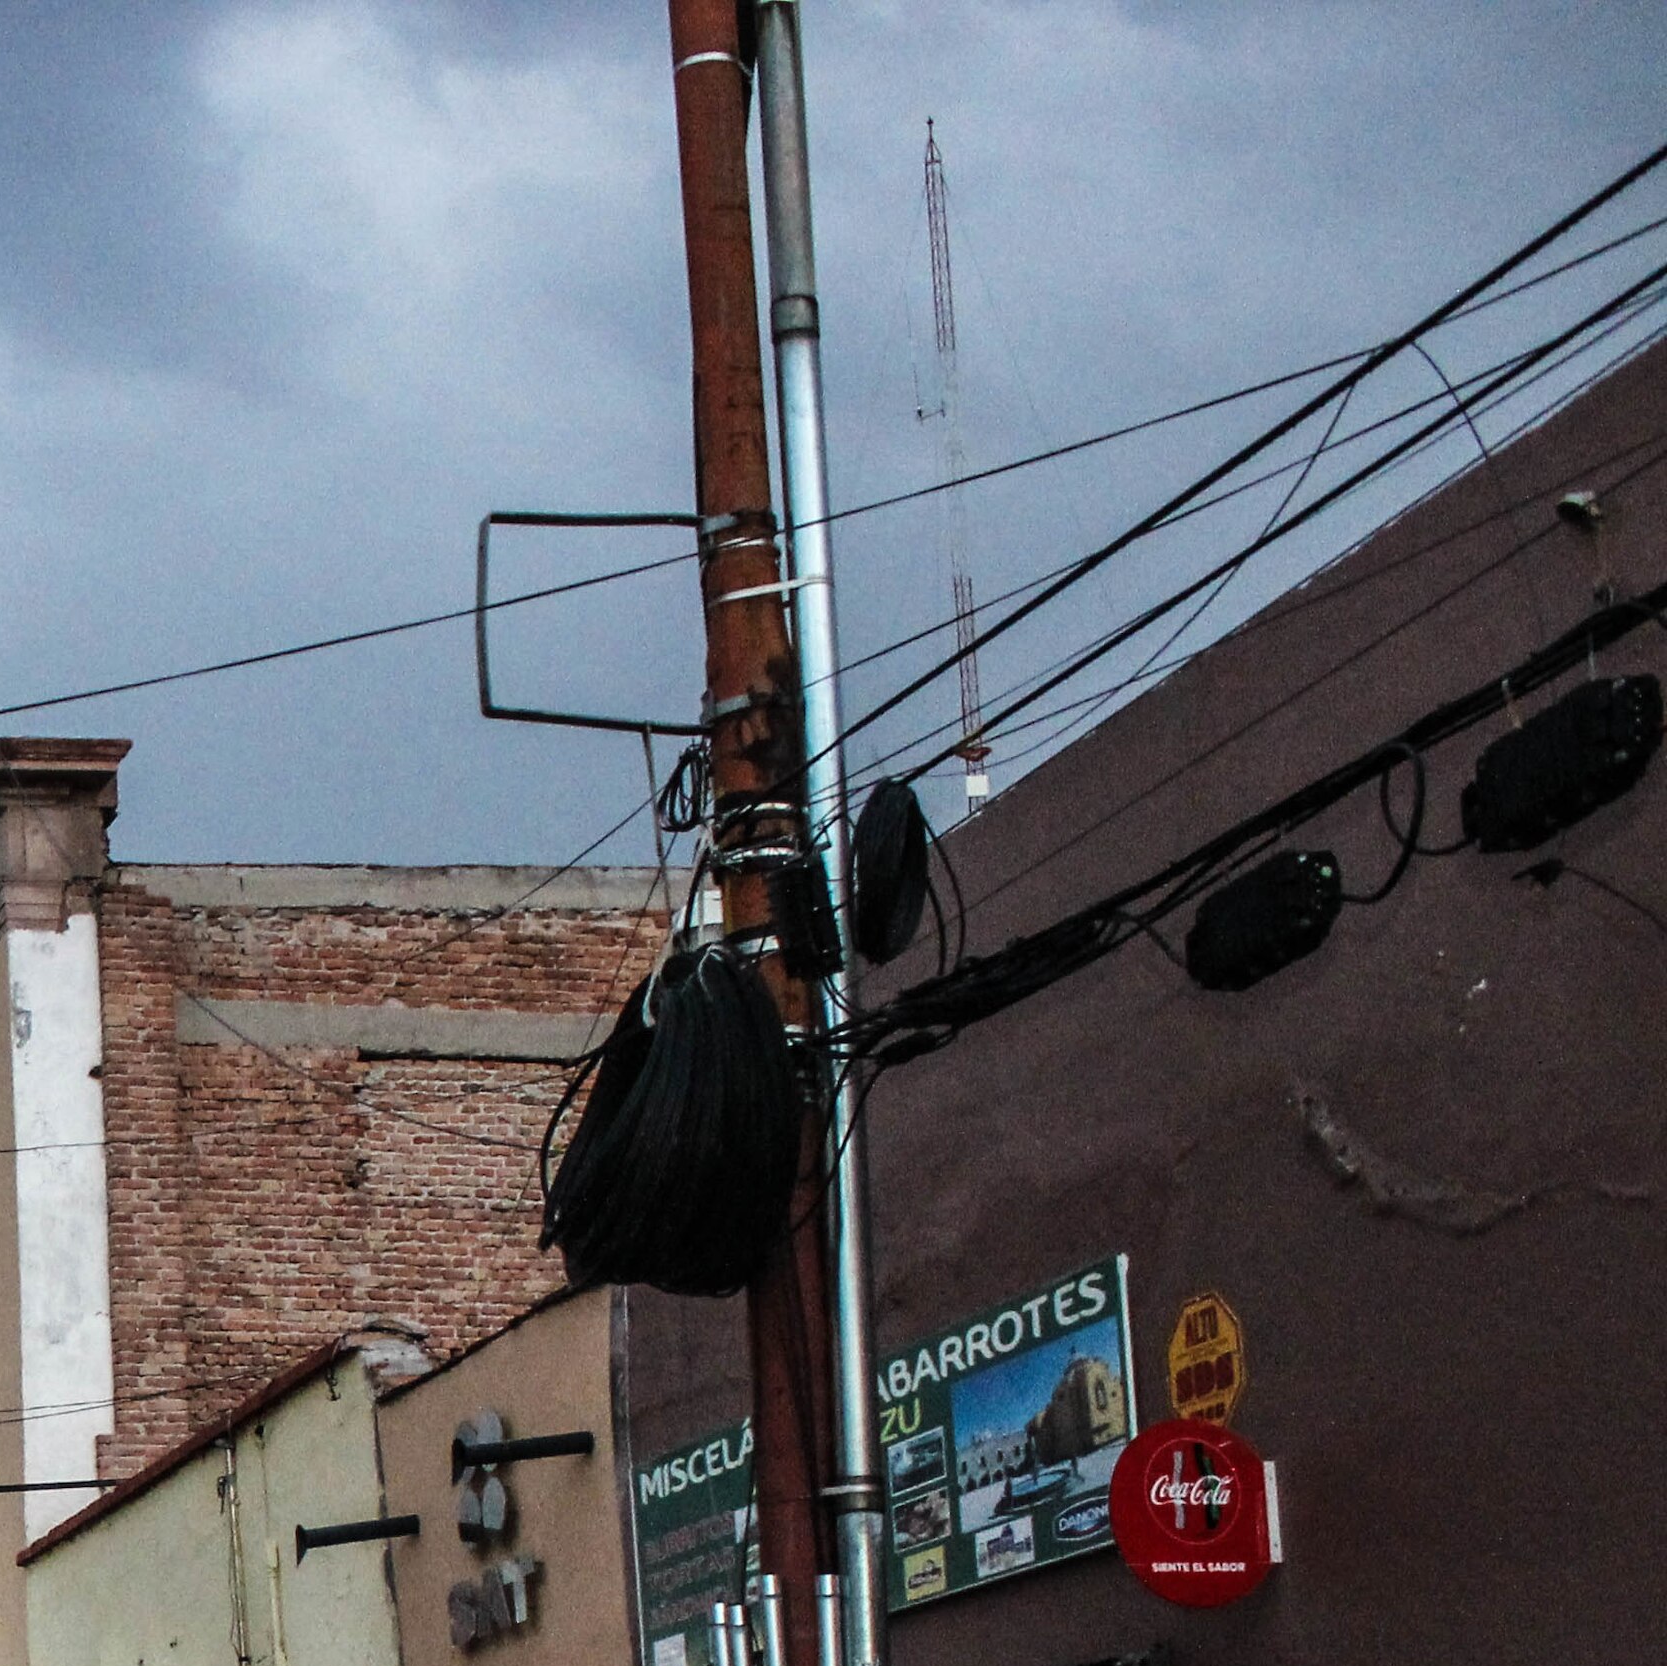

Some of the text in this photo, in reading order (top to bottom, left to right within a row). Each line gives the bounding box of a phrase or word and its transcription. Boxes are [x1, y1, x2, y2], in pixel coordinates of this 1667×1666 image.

[1151, 1474, 1233, 1505] Coca-Cola
[1151, 1562, 1246, 1573] SIENTE EL SABOR
